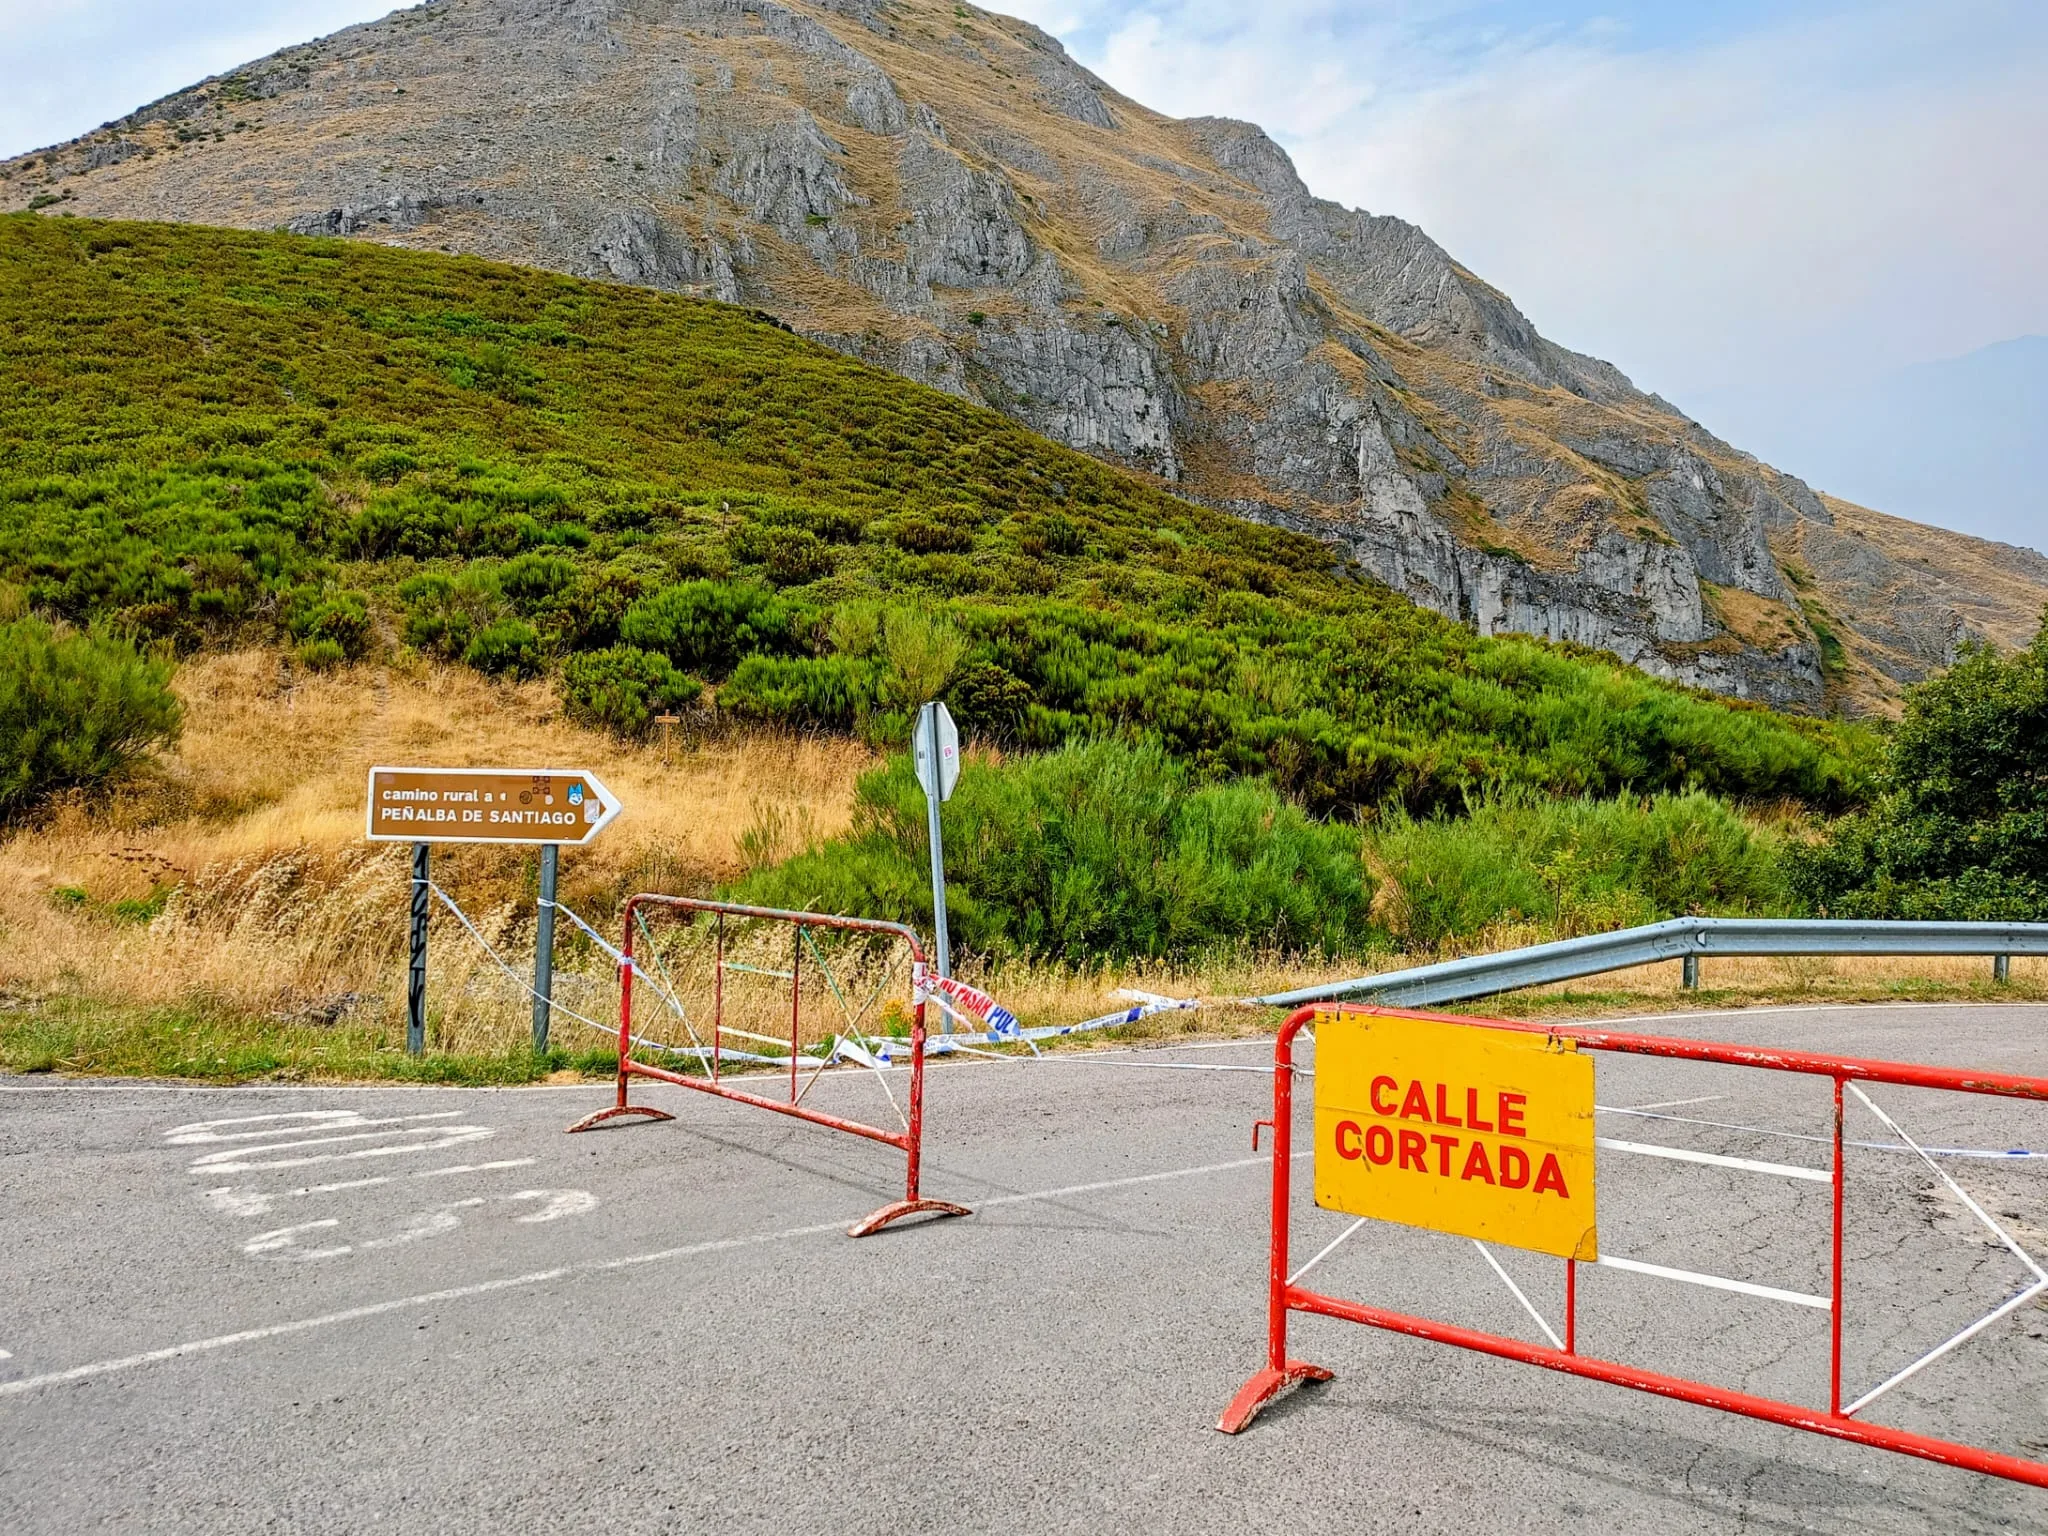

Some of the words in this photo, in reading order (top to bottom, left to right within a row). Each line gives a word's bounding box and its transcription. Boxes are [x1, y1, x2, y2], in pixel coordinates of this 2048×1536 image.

[382, 788, 438, 802] camino
[443, 789, 479, 803] rural
[484, 792, 493, 803] a
[381, 807, 458, 823] PEÑALBA
[462, 810, 483, 823] DE
[489, 810, 577, 825] SANTIAGO
[1370, 1075, 1527, 1138] CALLE
[1335, 1120, 1570, 1199] CORTADA
